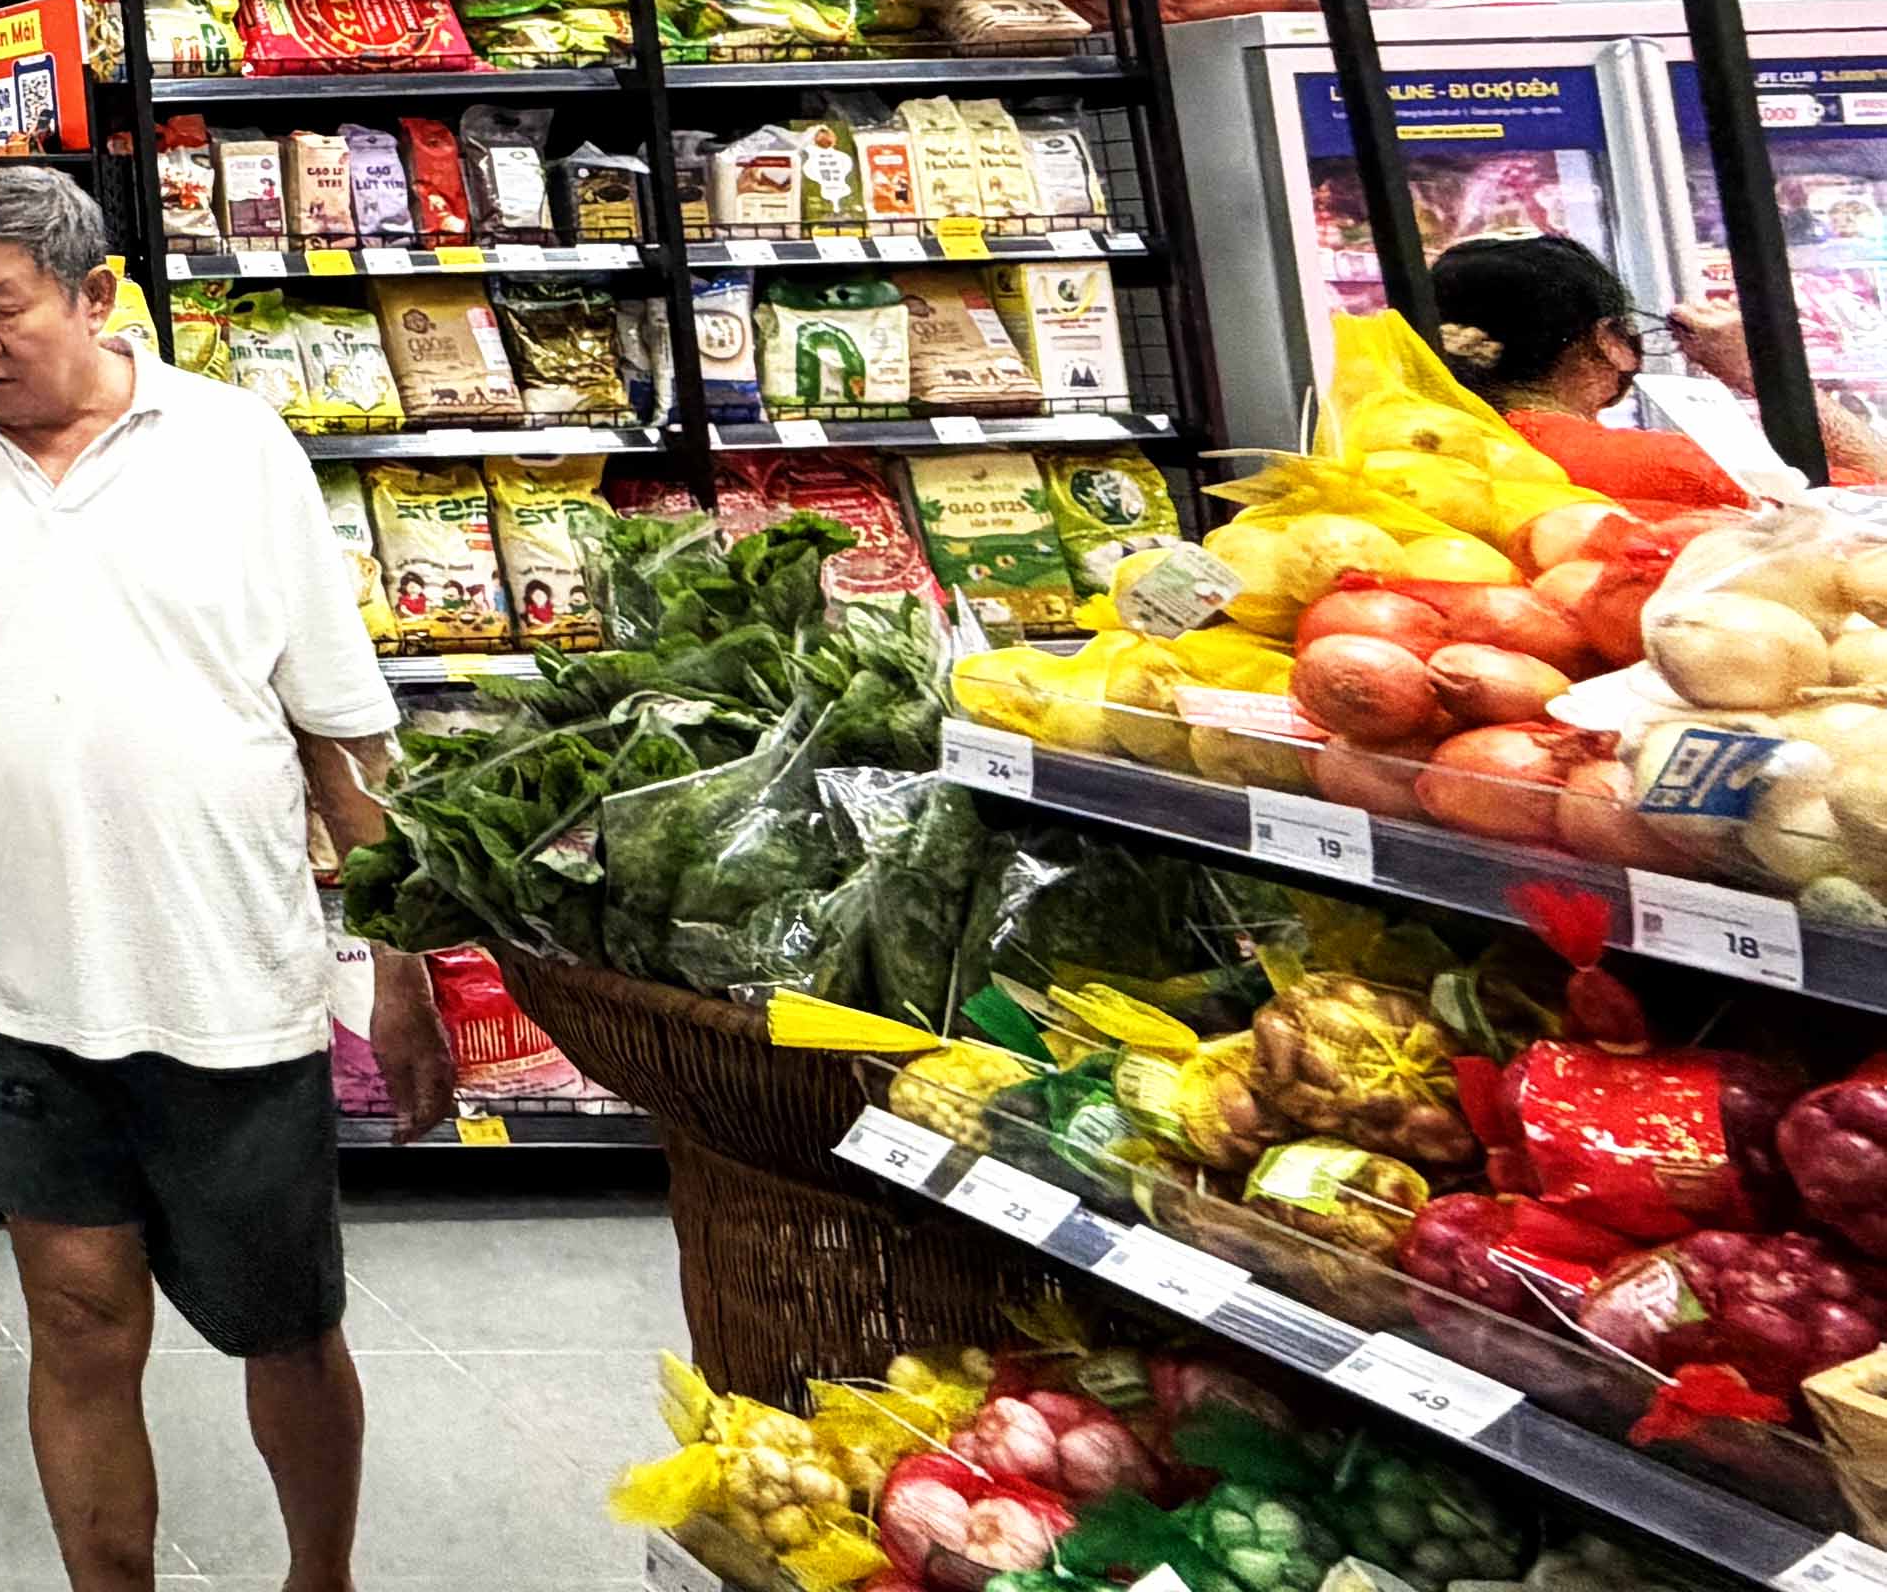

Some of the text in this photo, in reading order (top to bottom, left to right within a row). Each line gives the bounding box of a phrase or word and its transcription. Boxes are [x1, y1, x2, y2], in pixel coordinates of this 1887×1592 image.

[987, 758, 1012, 780] 24
[1316, 835, 1342, 859] 19
[1724, 931, 1761, 962] 18
[884, 1149, 910, 1168] 52
[1003, 1201, 1028, 1222] 23
[1407, 1388, 1451, 1411] 49
